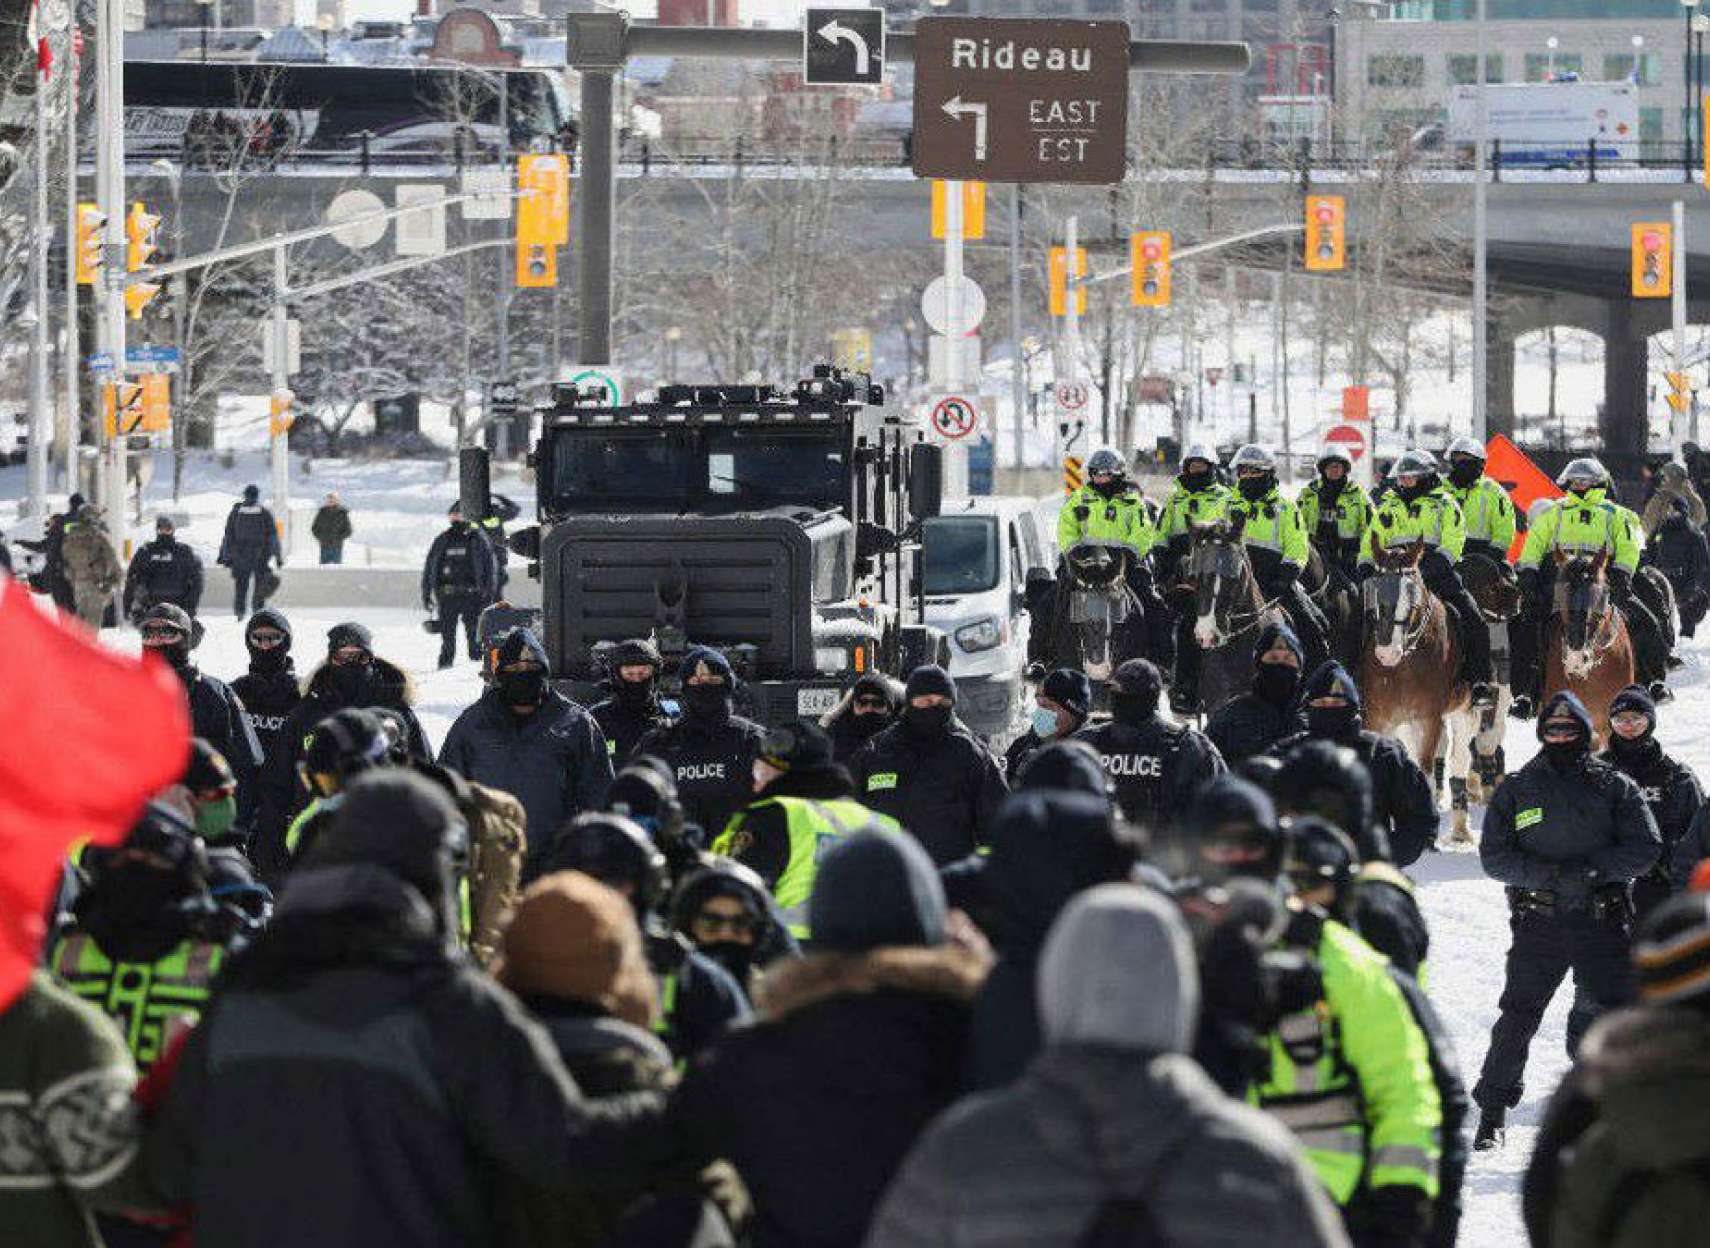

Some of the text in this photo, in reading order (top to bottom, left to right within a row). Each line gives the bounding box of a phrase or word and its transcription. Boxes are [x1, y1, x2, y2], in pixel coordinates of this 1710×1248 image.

[951, 38, 1092, 71] Rideau
[1029, 100, 1101, 123] EAST
[1038, 138, 1089, 162] EST
[677, 762, 725, 781] POLICE
[1100, 754, 1162, 777] POLICE
